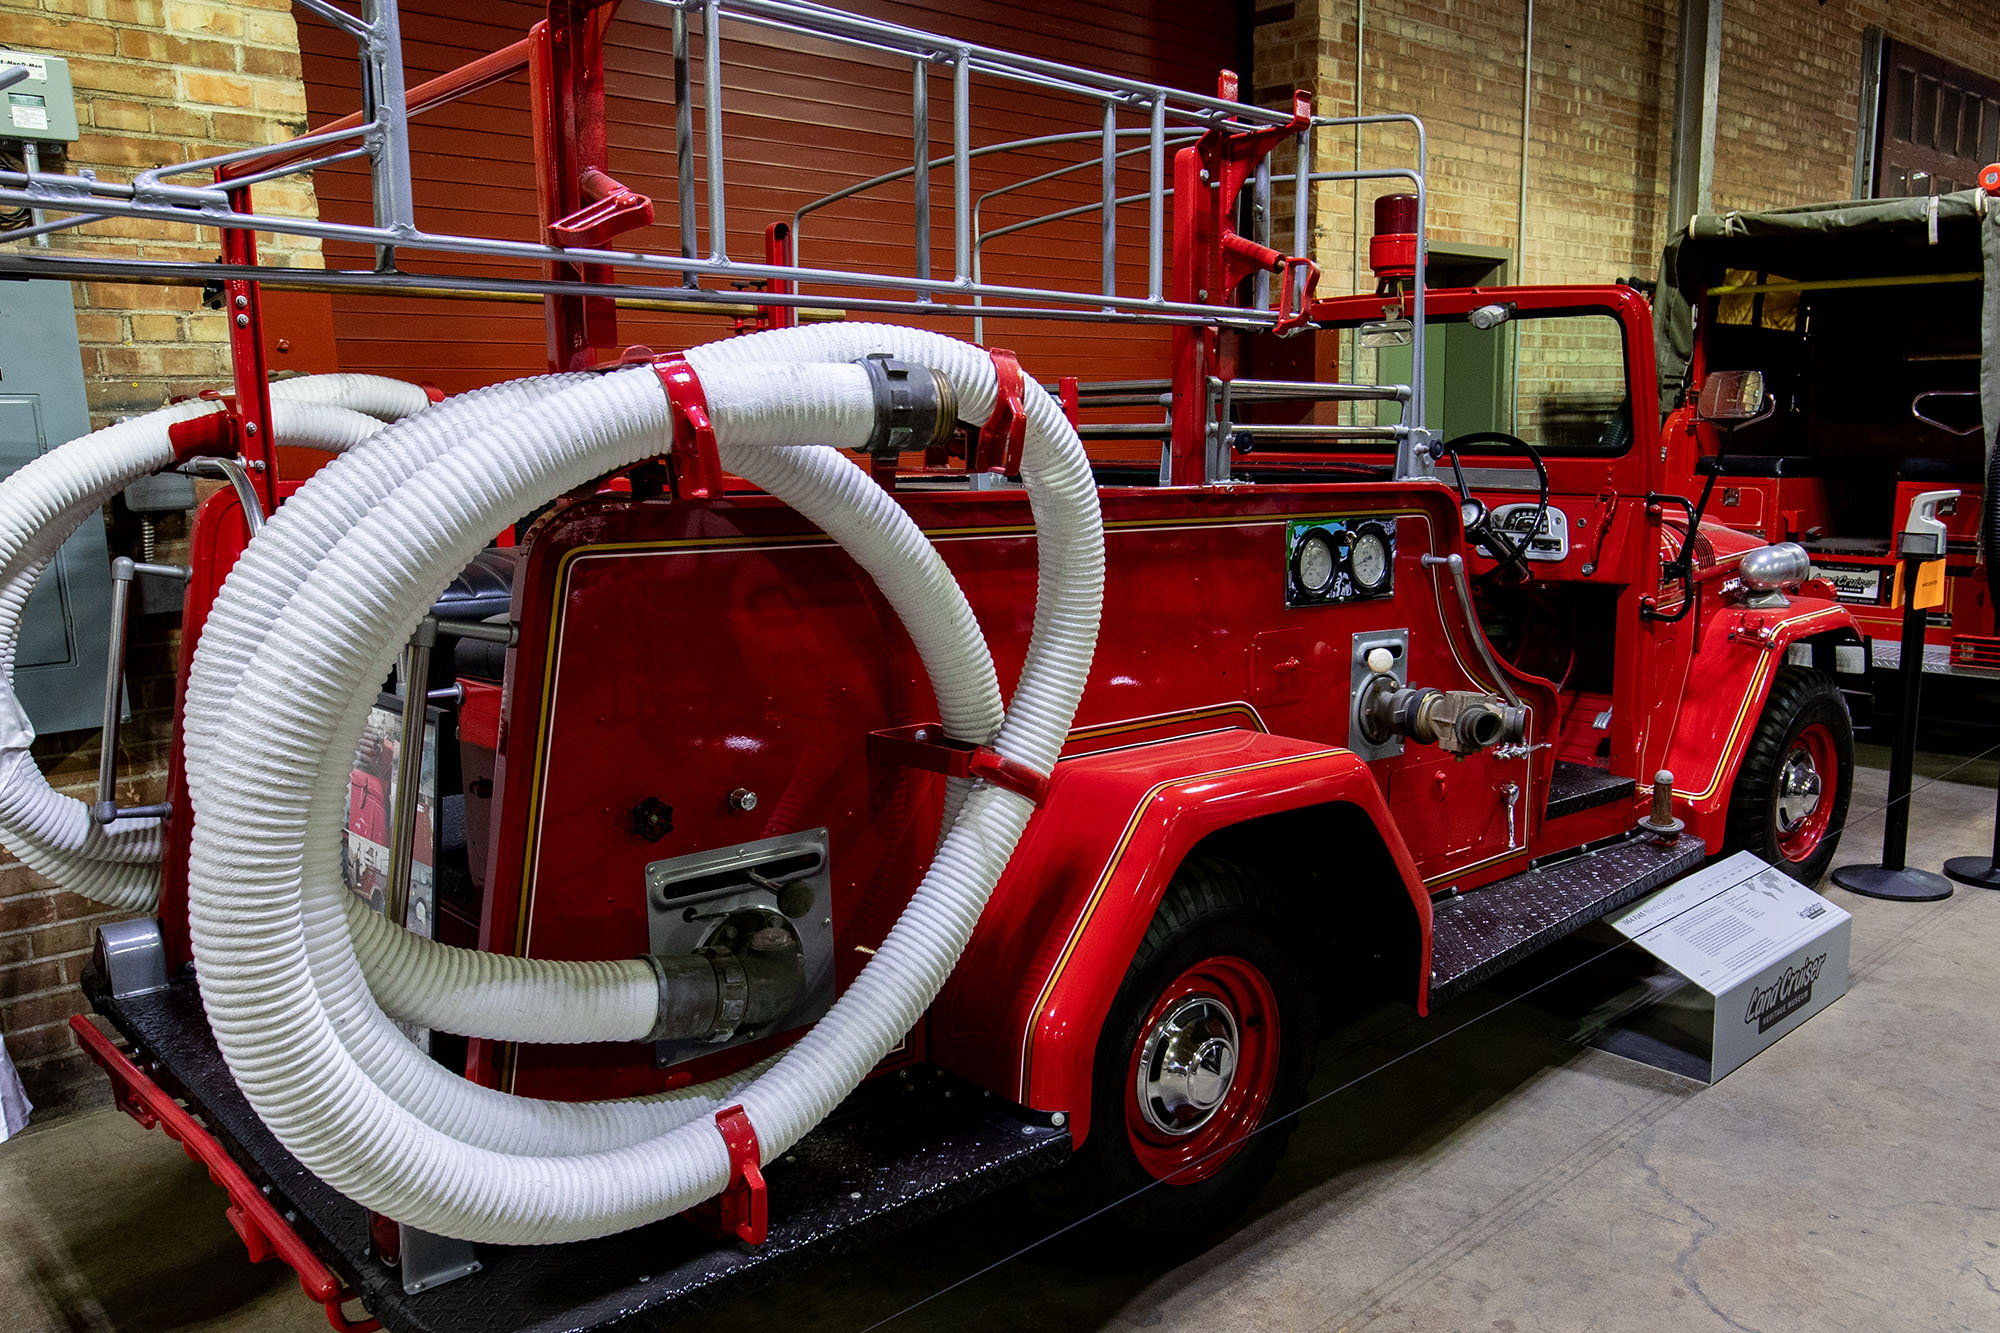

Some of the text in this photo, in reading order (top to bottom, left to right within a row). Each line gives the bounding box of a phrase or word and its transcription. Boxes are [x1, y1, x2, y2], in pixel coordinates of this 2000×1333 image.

[1811, 573, 1877, 589] Ld Cruiser
[1745, 976, 1784, 1024] Land
[1780, 953, 1827, 1001] Cruiser
[1761, 990, 1809, 1026] HERITAGE MUSEUM
